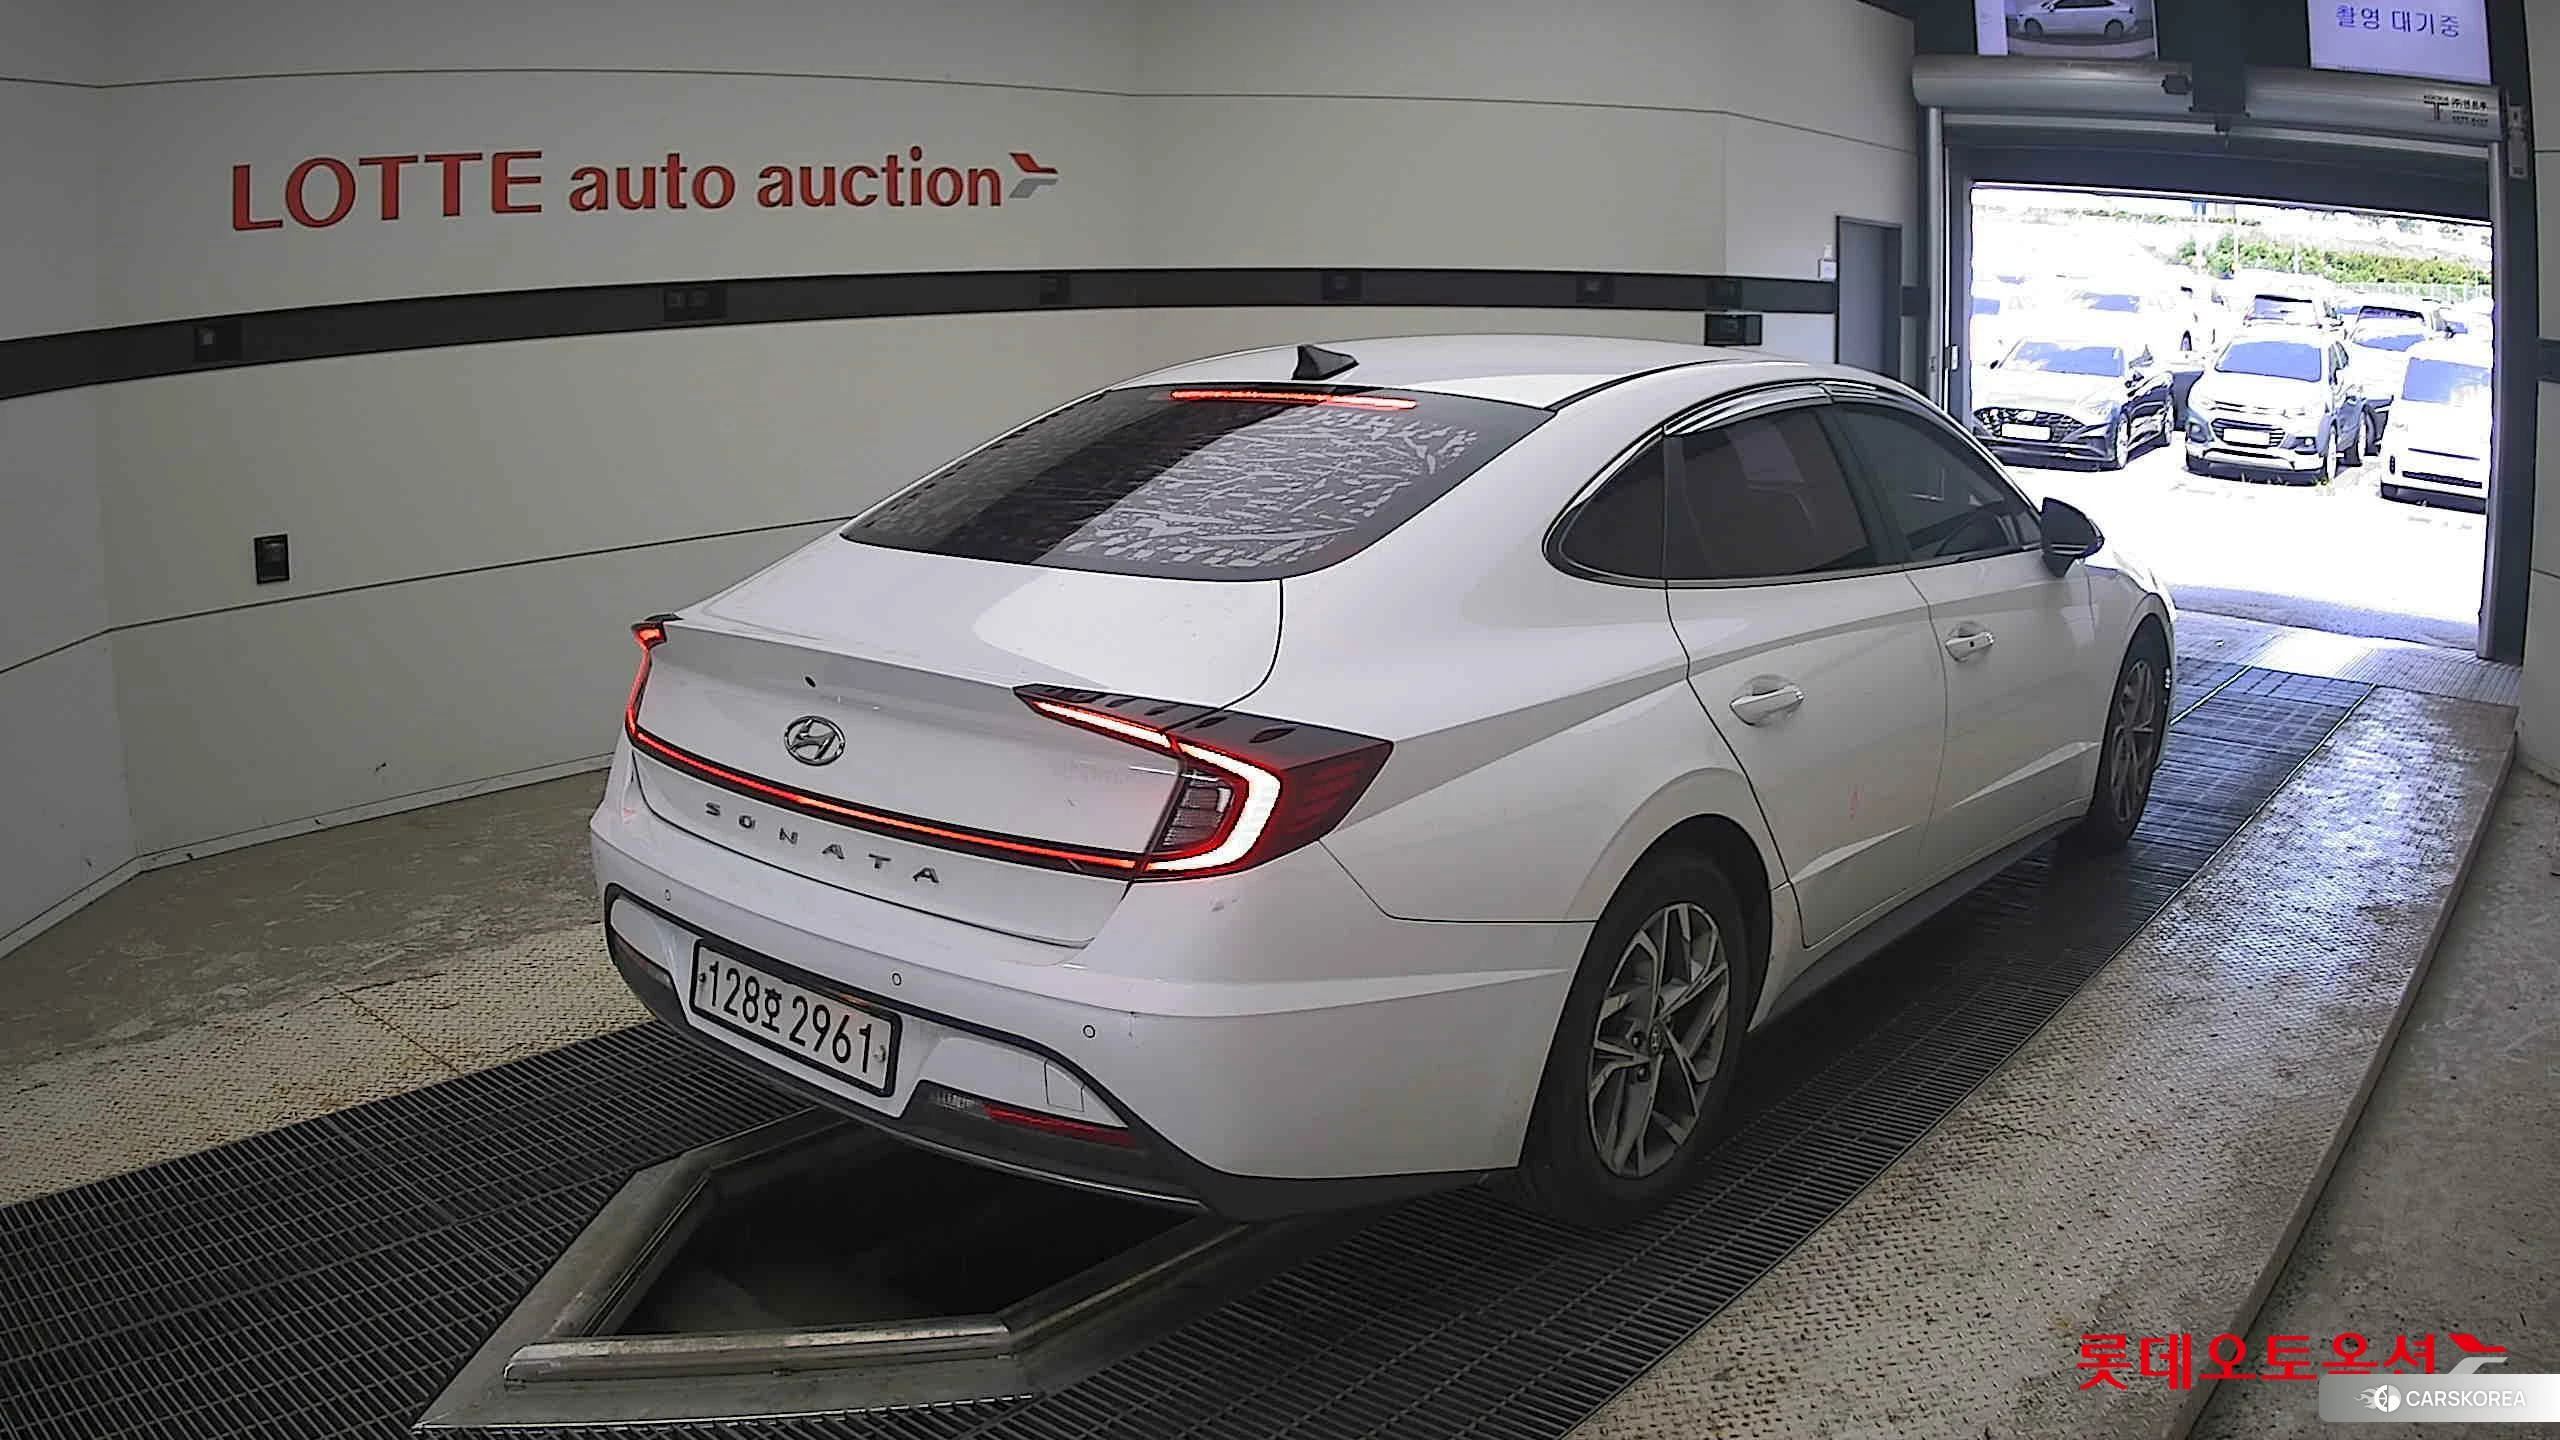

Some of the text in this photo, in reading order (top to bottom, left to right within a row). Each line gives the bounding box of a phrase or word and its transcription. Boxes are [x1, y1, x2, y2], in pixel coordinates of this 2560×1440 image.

[2336, 5, 2460, 38] 촬영 대기중
[233, 146, 1002, 231] LOTTE auto auction
[704, 802, 940, 884] SONATA
[709, 961, 872, 1074] 128호 2961
